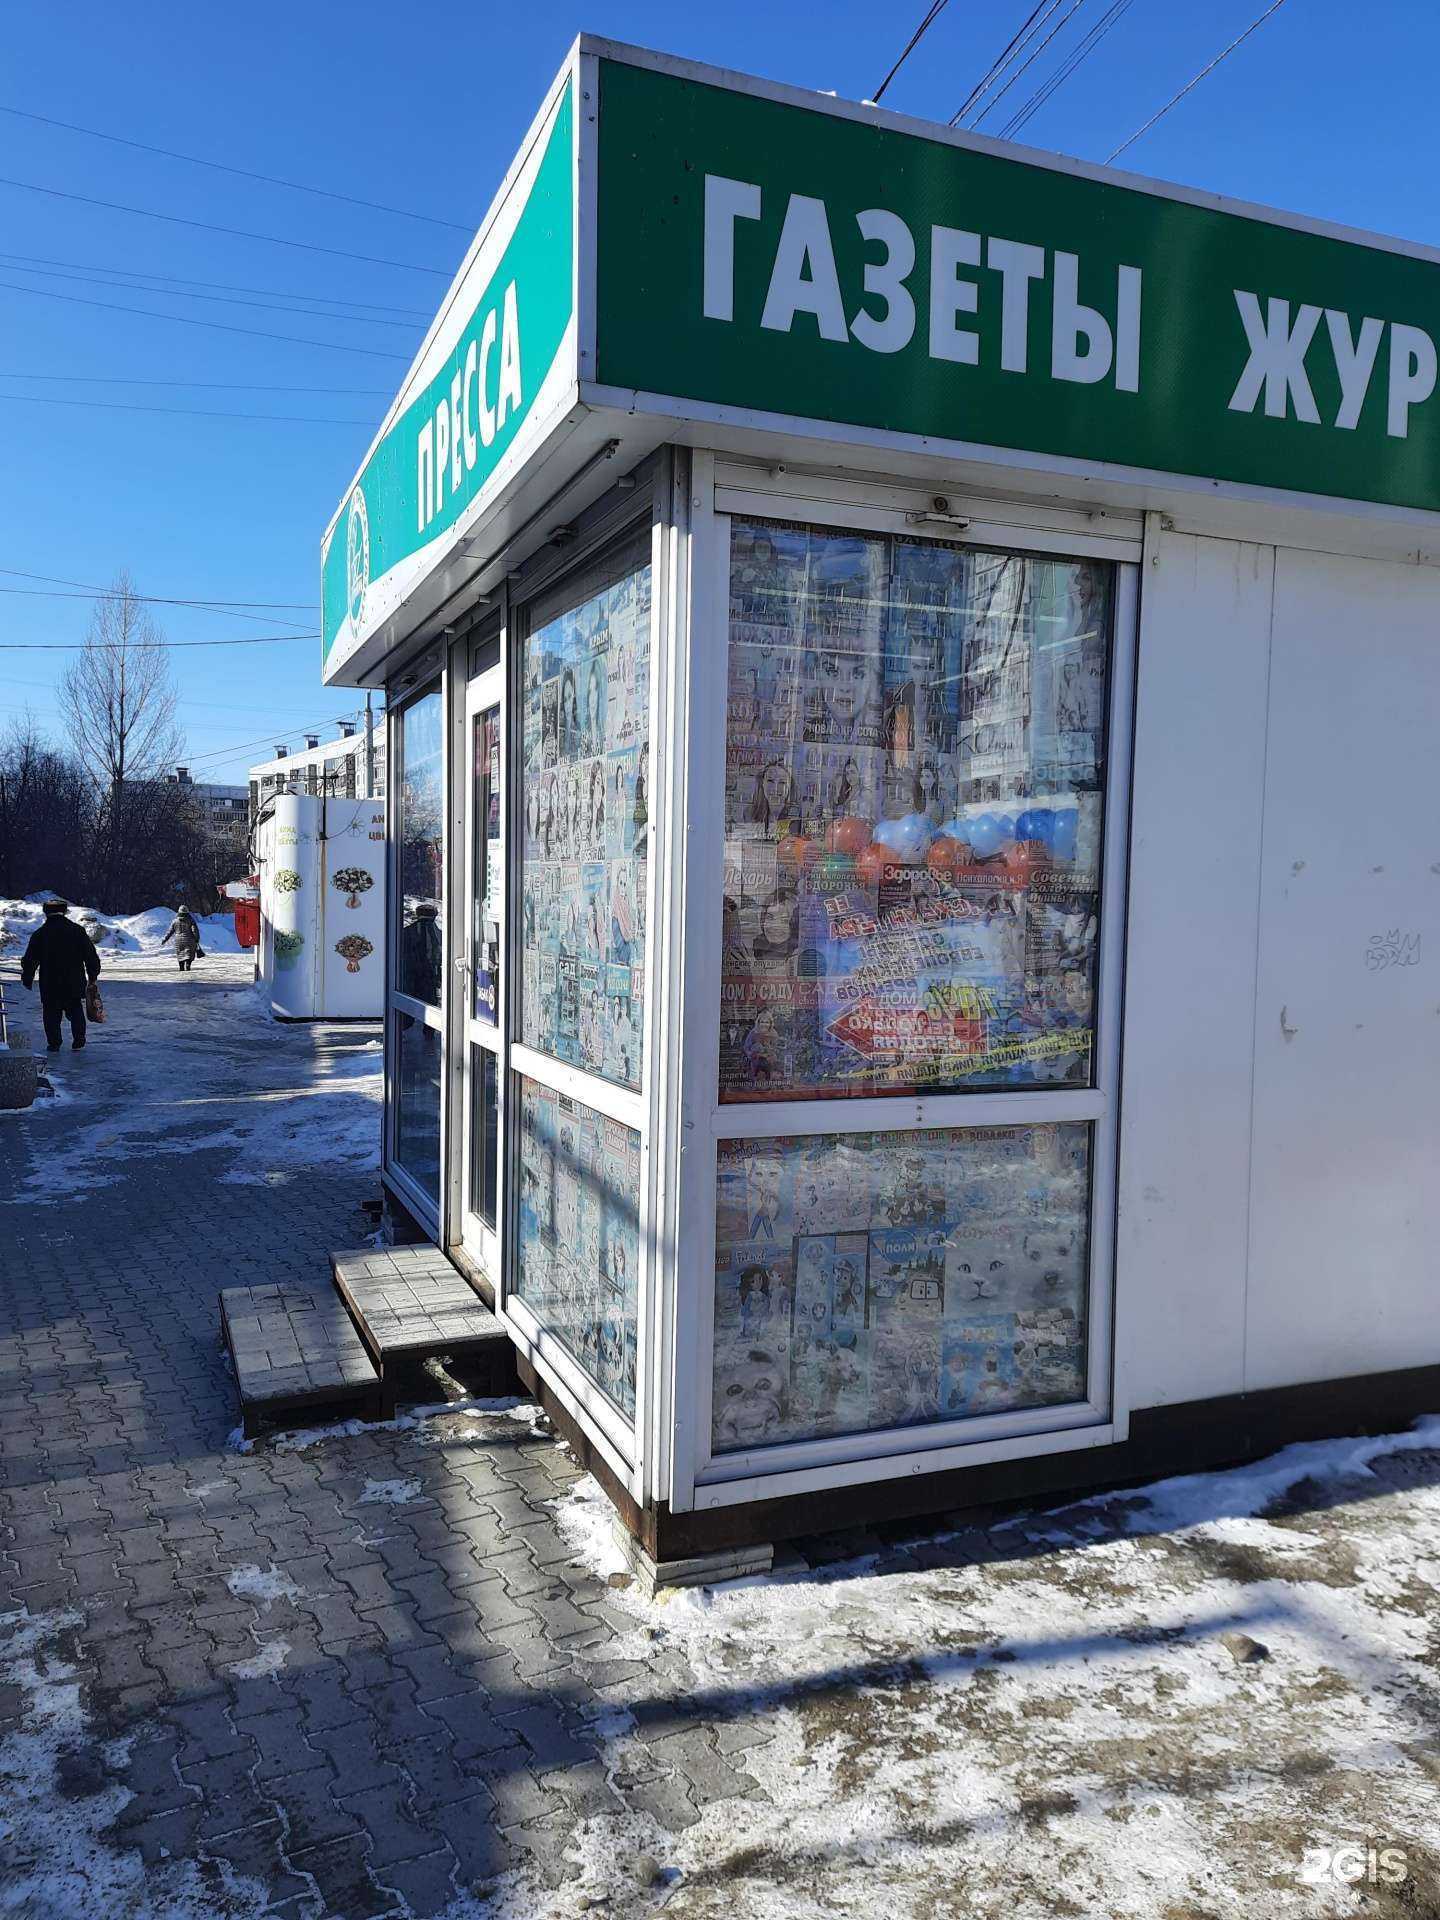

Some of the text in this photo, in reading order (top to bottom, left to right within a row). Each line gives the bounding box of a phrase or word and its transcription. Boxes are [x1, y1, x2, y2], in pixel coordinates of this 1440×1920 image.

[417, 279, 522, 534] ПРЕССА
[703, 173, 1439, 438] ГАЗЕТЫ ЖУР
[759, 979, 796, 1000] САДУ
